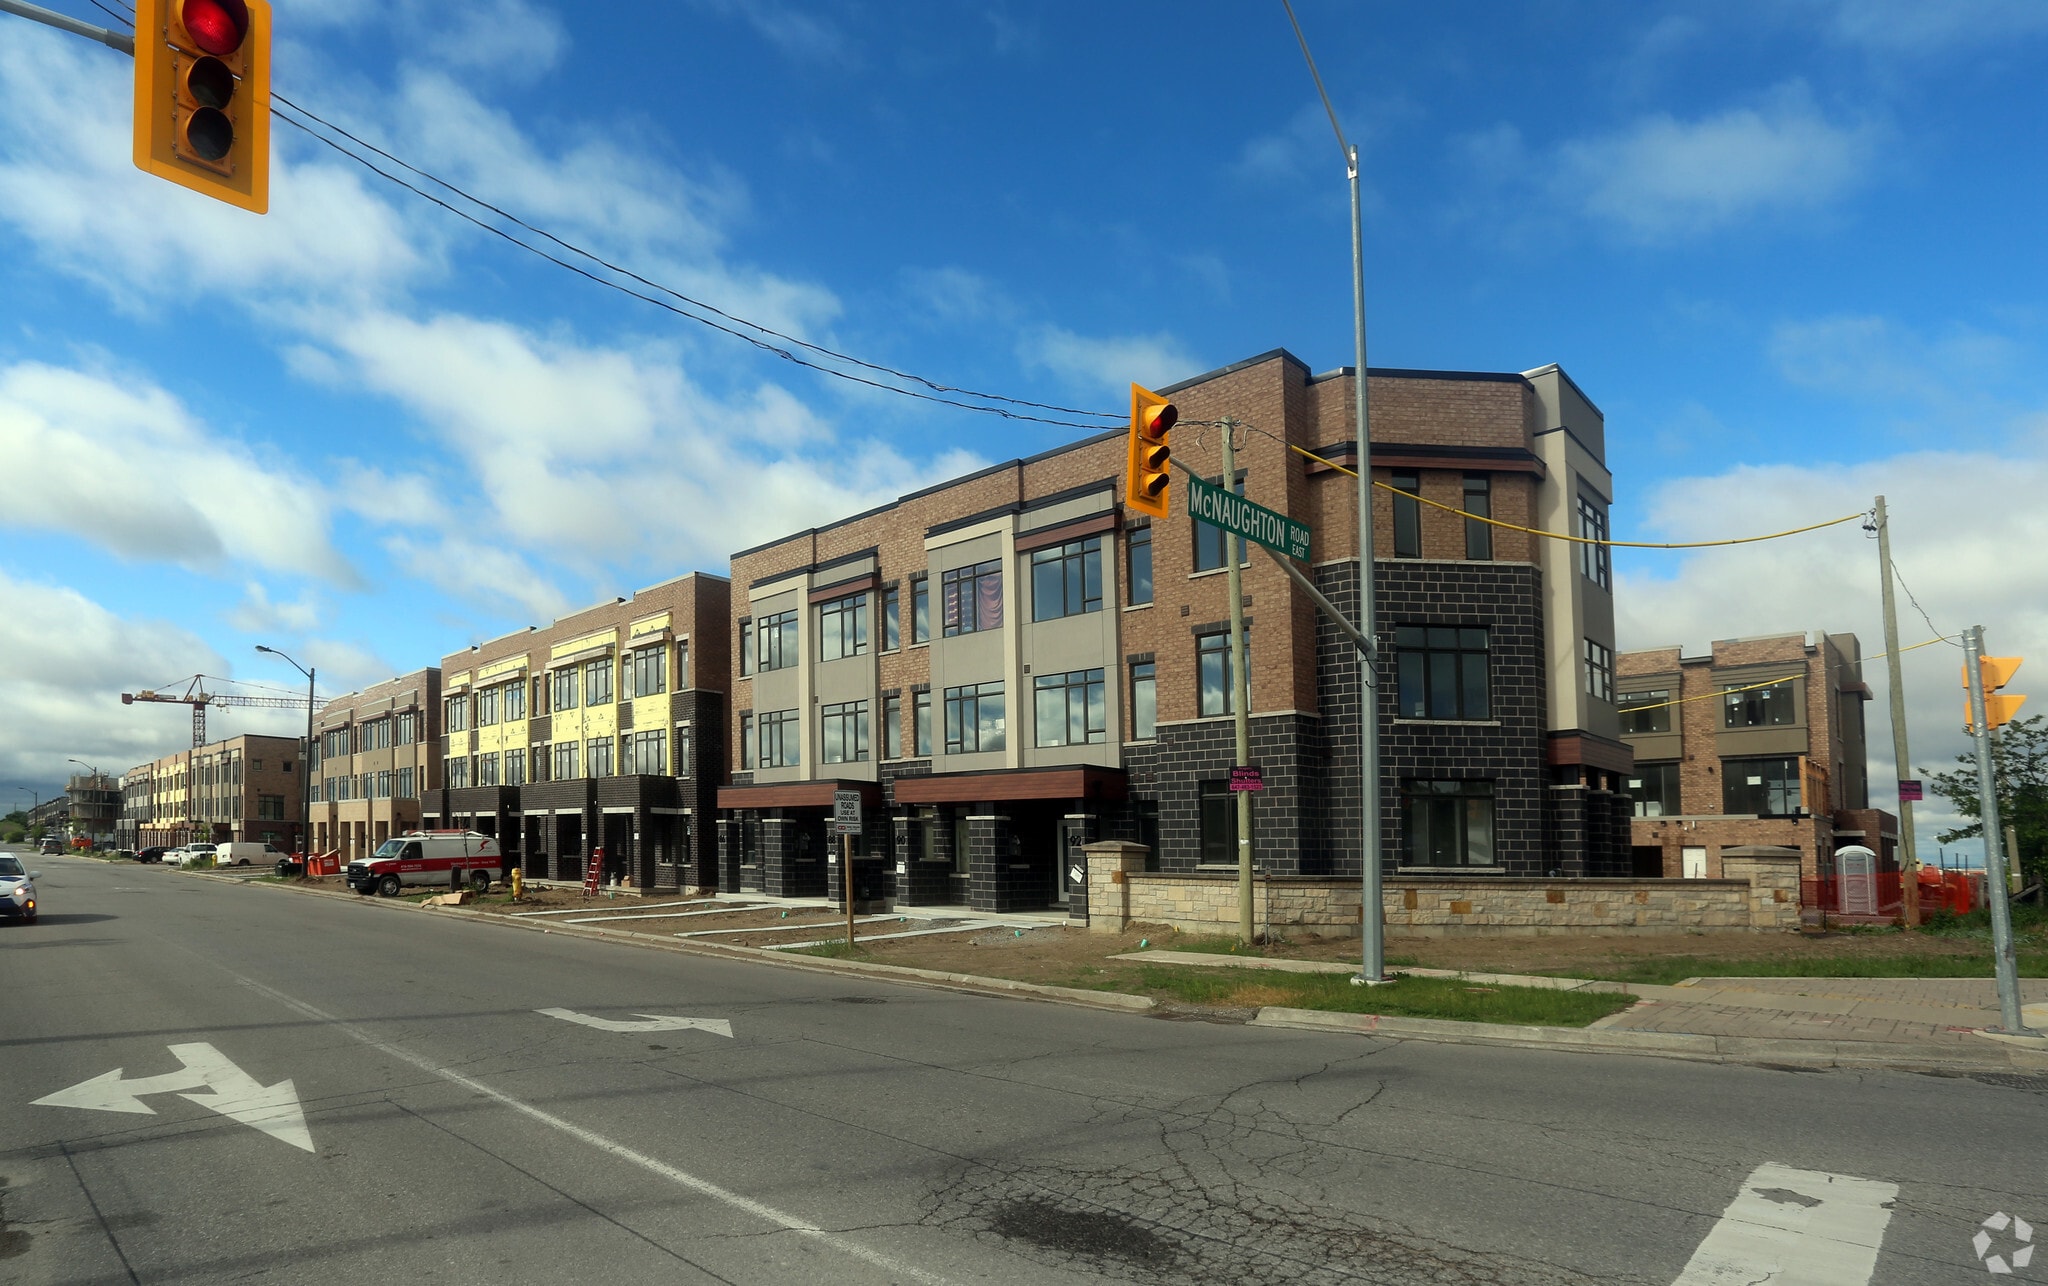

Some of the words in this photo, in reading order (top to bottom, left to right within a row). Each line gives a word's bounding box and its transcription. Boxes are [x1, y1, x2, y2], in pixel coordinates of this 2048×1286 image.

[1191, 481, 1285, 548] McNAUGHTON
[1290, 525, 1310, 547] ROAD
[1292, 545, 1305, 559] EAST
[835, 793, 859, 802] UNASSUMED
[840, 802, 855, 810] ROADS
[896, 835, 906, 845] 90
[1070, 835, 1082, 846] 92
